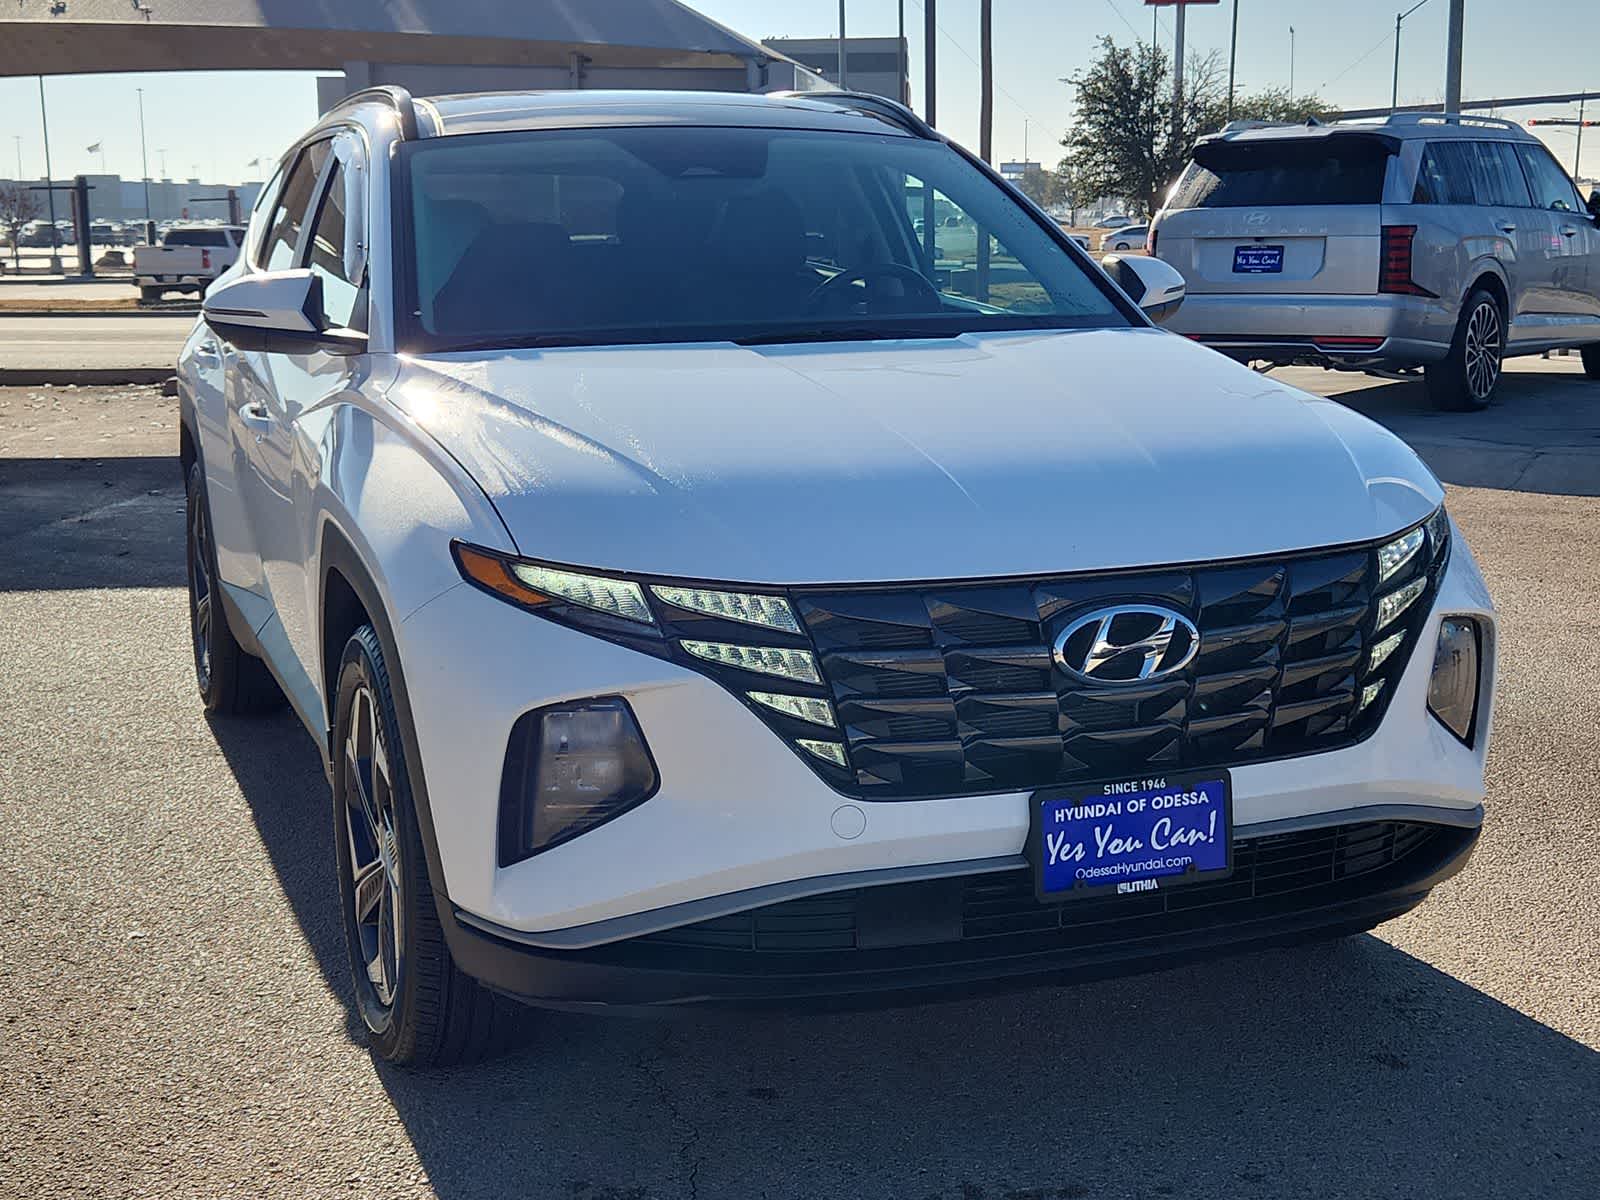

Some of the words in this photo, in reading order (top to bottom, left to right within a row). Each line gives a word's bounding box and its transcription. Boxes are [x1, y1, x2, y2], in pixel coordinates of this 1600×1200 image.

[1103, 779, 1138, 796] SINCE
[1141, 777, 1166, 792] 1946
[1055, 802, 1121, 823] HYUNDAI
[1126, 799, 1147, 813] OF
[1151, 791, 1209, 810] ODESSA
[1046, 830, 1086, 865] Yes
[1094, 823, 1143, 858] You
[1150, 810, 1217, 850] Can!
[1075, 856, 1192, 879] OdessaHyundai.com
[1127, 878, 1159, 892] LITHIA
